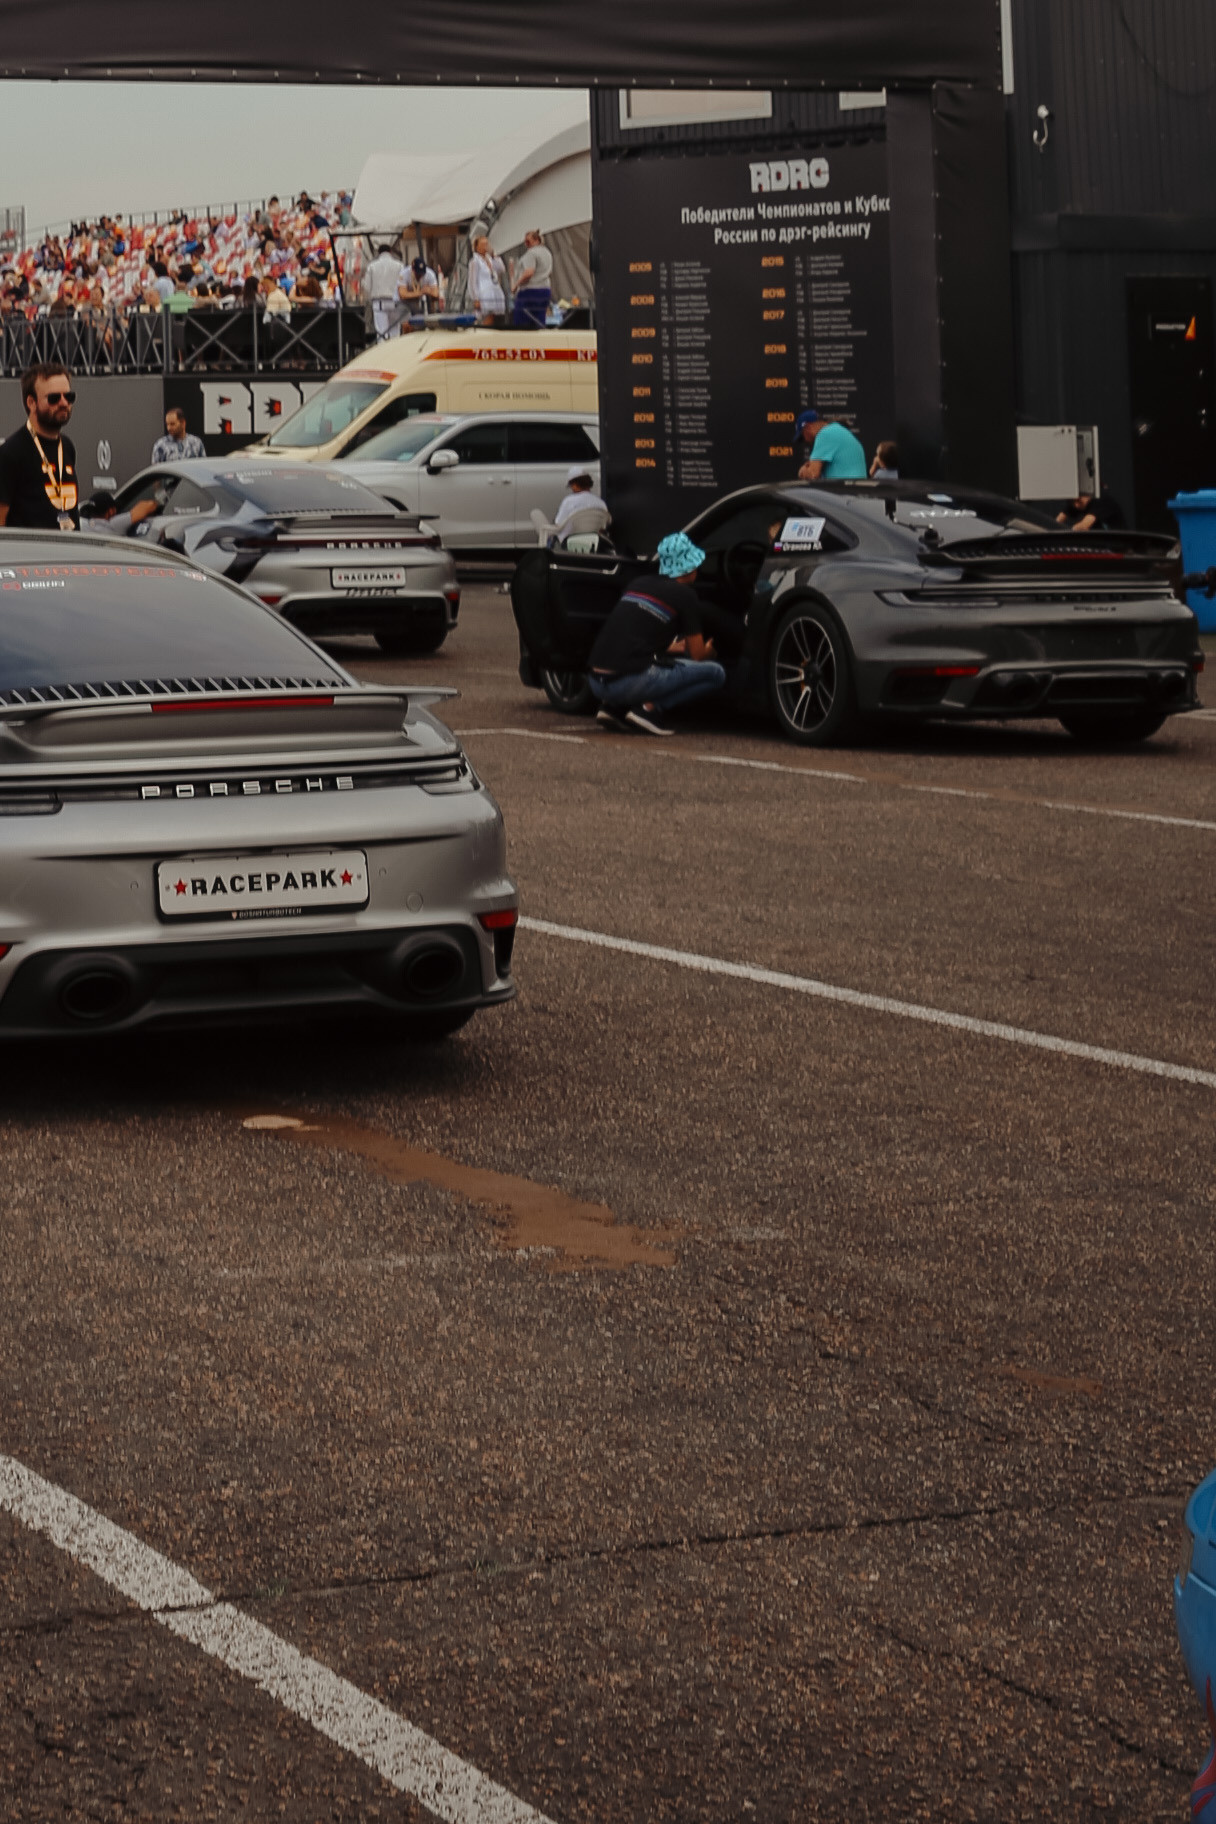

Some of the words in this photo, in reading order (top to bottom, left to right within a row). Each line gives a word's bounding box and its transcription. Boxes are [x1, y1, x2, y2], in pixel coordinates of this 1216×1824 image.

[748, 157, 830, 193] RDRC
[681, 206, 755, 225] Победители
[757, 199, 842, 221] Чемпионатов
[844, 201, 853, 214] и
[714, 227, 758, 245] России
[761, 227, 776, 243] по
[778, 221, 871, 244] дрэг-рейсингу
[141, 776, 354, 800] PORSCHE
[190, 868, 338, 897] RACEPARK
